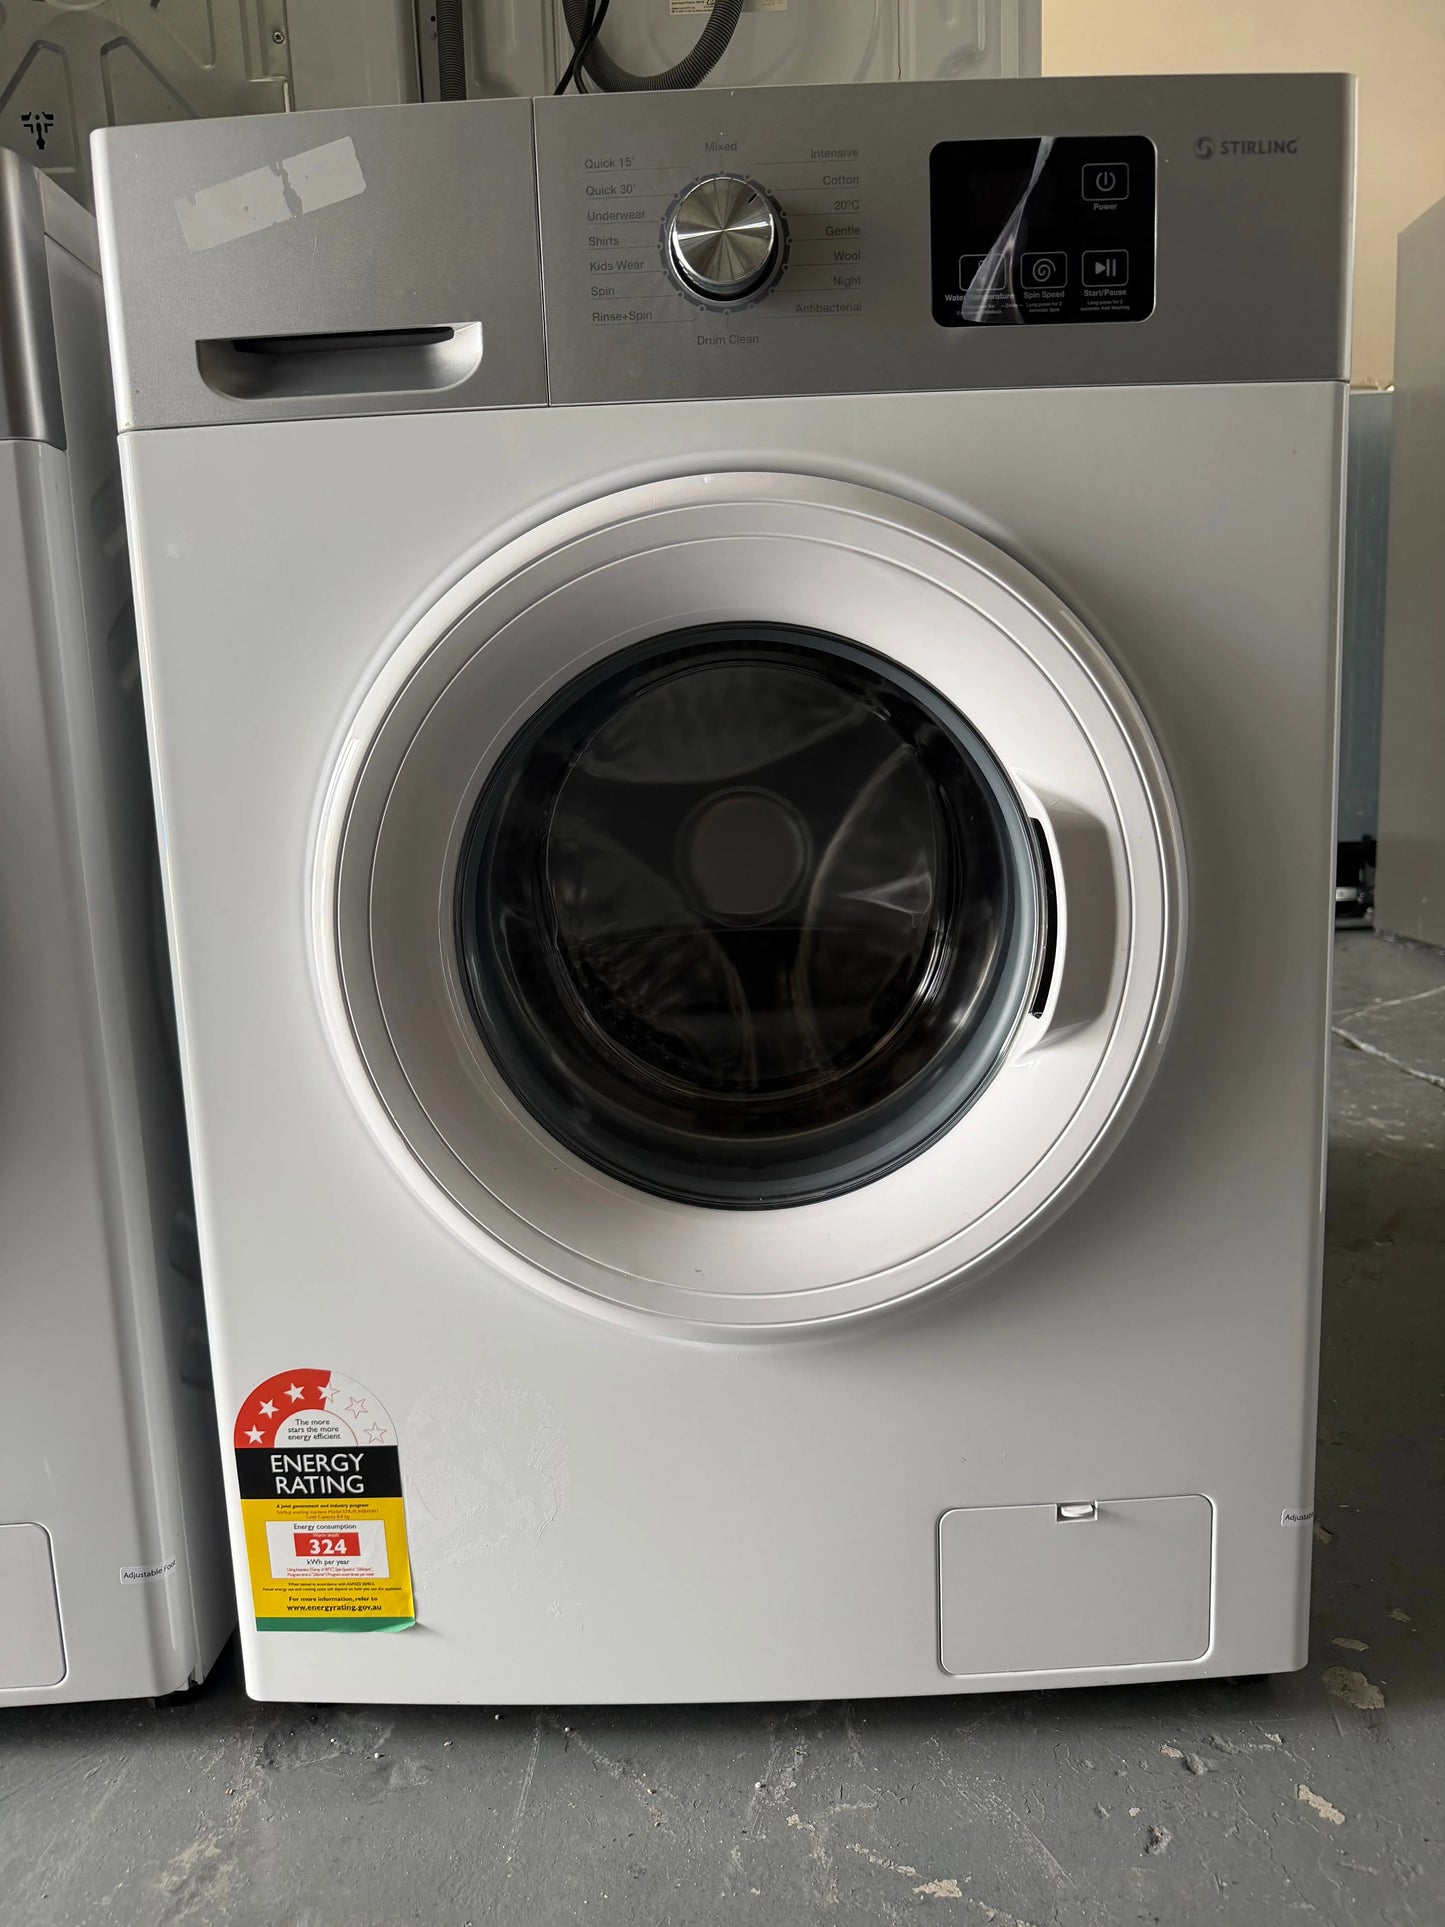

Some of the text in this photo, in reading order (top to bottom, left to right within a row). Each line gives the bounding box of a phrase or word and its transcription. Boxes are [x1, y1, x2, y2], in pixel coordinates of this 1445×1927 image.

[705, 141, 737, 151] Mixed
[1220, 140, 1297, 154] STIRLING
[810, 149, 859, 159] Intensive
[584, 157, 635, 168] Quick 15'
[822, 175, 860, 185] Cotton
[586, 184, 636, 195] Quick 30'
[587, 211, 646, 221] Underwear
[825, 226, 861, 236] Gentle
[588, 236, 620, 246] Shirts
[834, 251, 861, 260] Wool
[590, 260, 644, 271] Kids Wear
[833, 276, 862, 287] Night
[591, 286, 615, 297] Spin
[1024, 290, 1065, 299] Spin Speed
[795, 303, 862, 313] Antibacterial
[592, 311, 653, 321] Rinse+Spin
[697, 334, 759, 345] Drum Clean
[270, 1453, 364, 1472] ENERGY
[275, 1475, 365, 1494] RATING
[309, 1538, 347, 1554] 324
[123, 1568, 163, 1579] Adjustable
[287, 1603, 382, 1611] www.energyrating.gov.au
